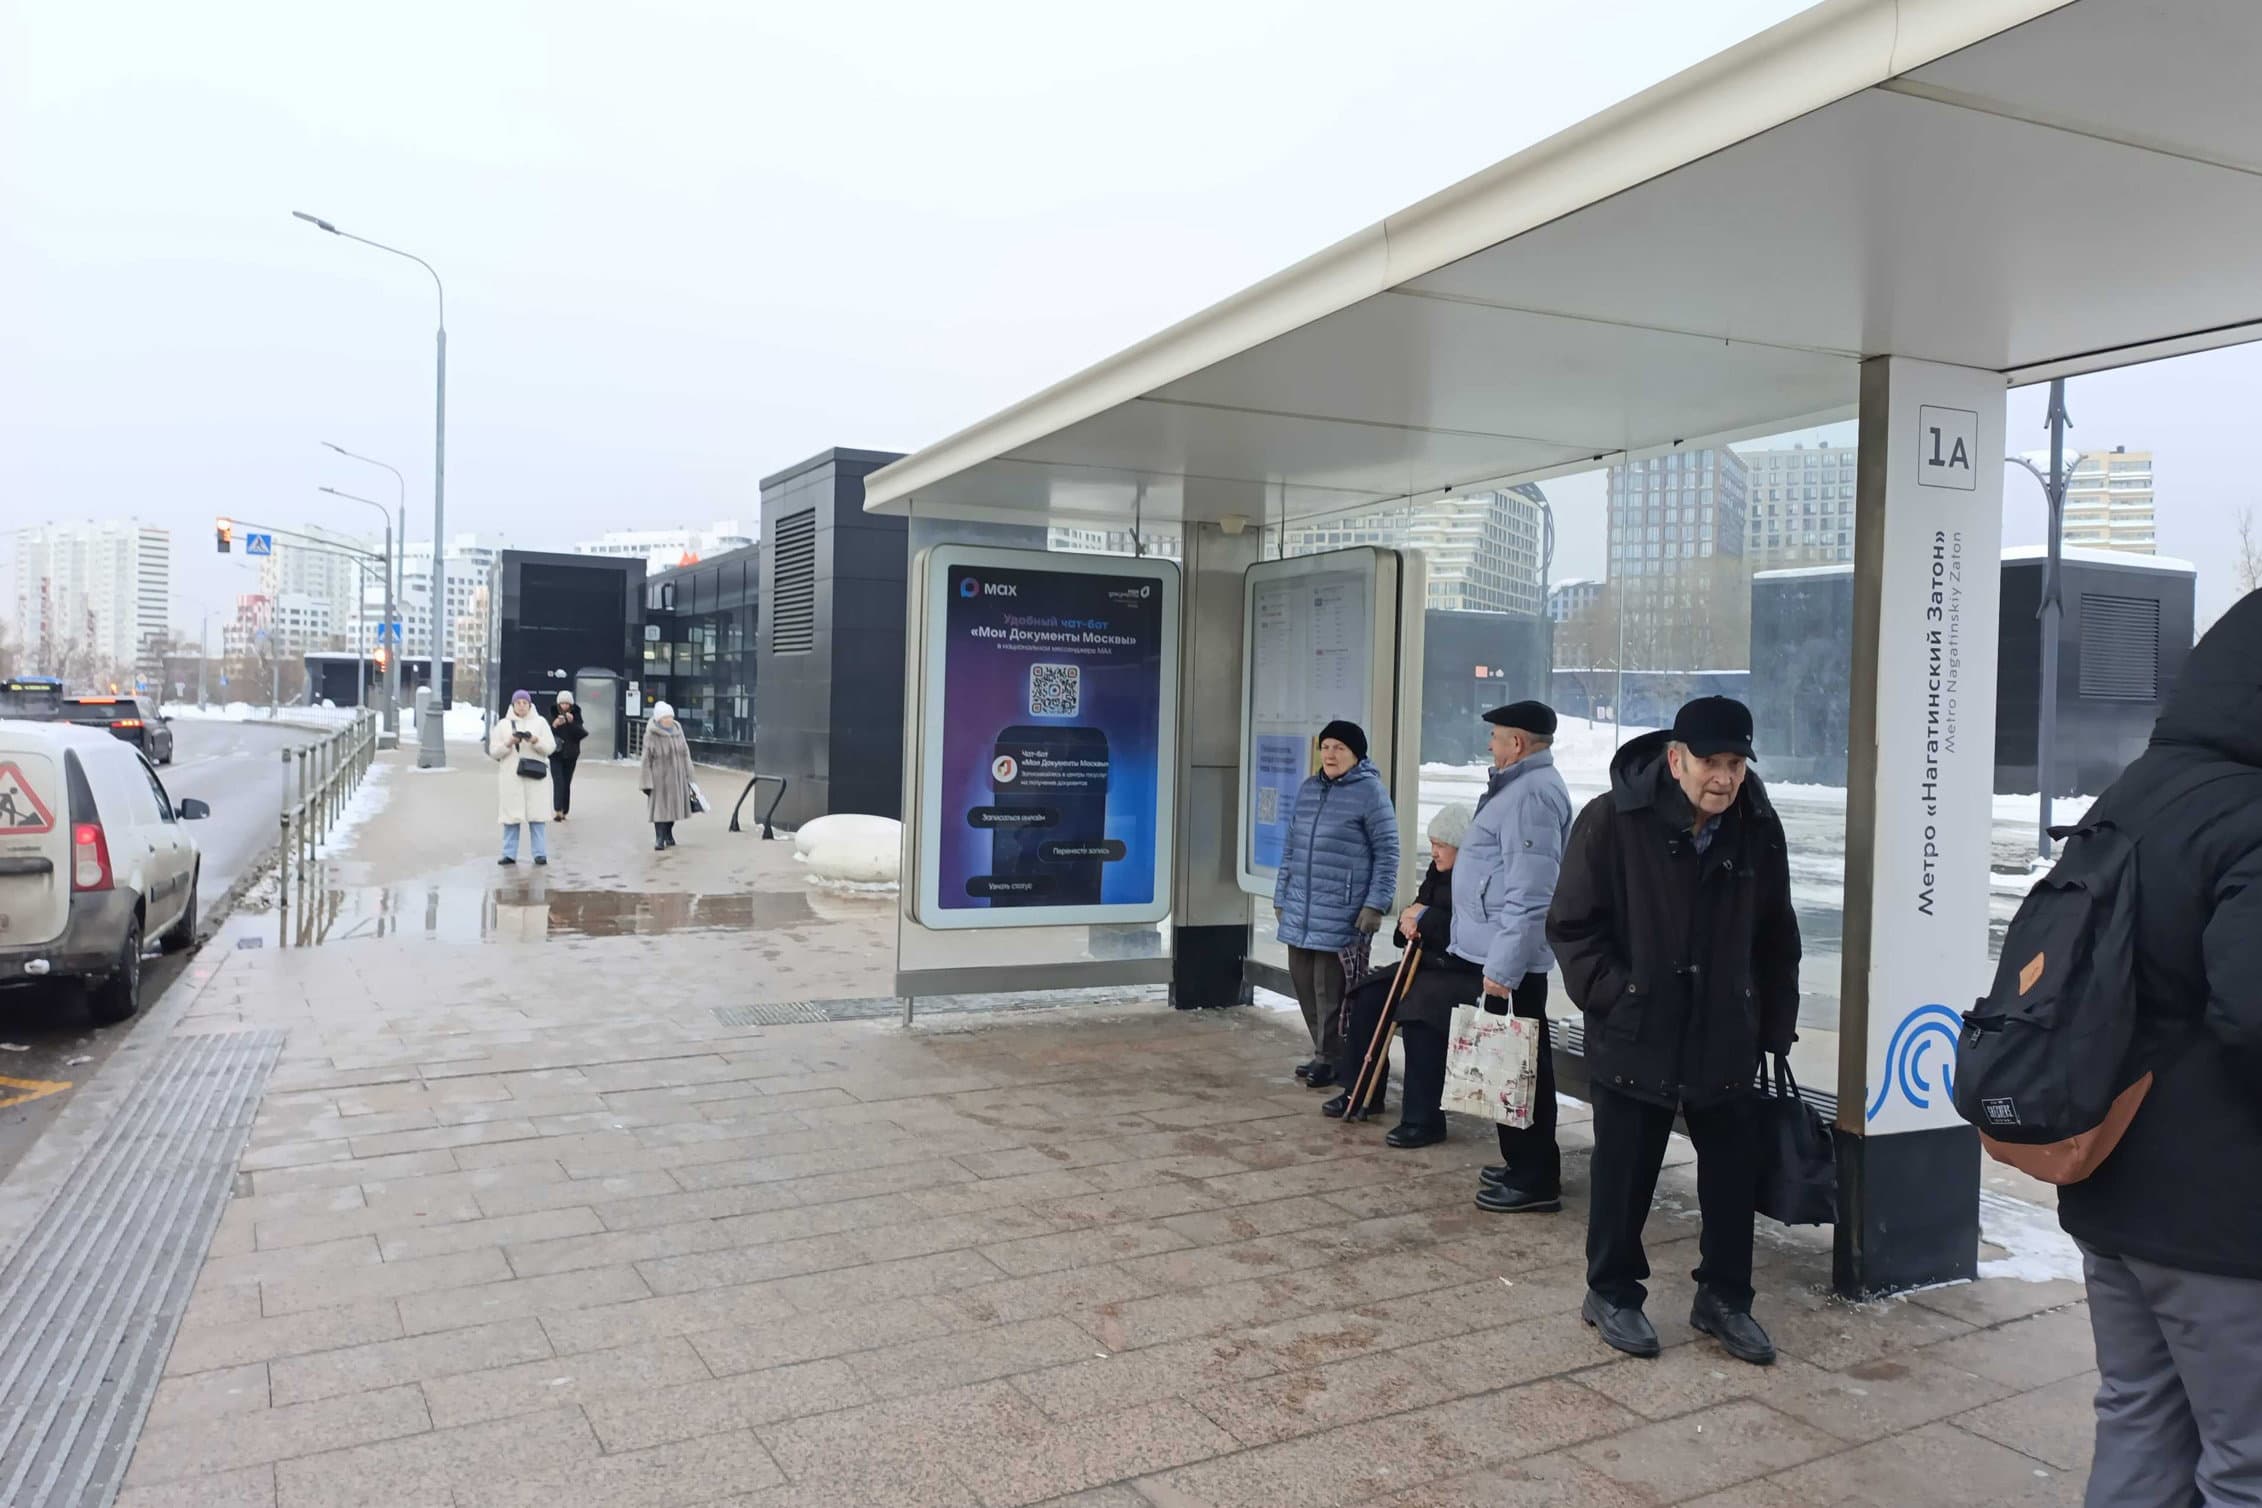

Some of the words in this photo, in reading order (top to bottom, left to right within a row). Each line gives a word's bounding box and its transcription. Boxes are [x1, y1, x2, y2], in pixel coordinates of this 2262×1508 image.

[1927, 530, 1945, 622] Затон»
[1949, 531, 1962, 583] Zaton
[970, 625, 1007, 638] «Мои
[1009, 628, 1081, 642] Документы
[1082, 632, 1137, 645] Москвы»
[1003, 613, 1058, 627] Удобный
[1061, 618, 1110, 630] чат-бот
[1947, 587, 1962, 692] Nagatinskiy
[1921, 630, 1943, 816] «Нагатинский
[1944, 698, 1957, 754] Metro
[1918, 825, 1939, 916] Метро
